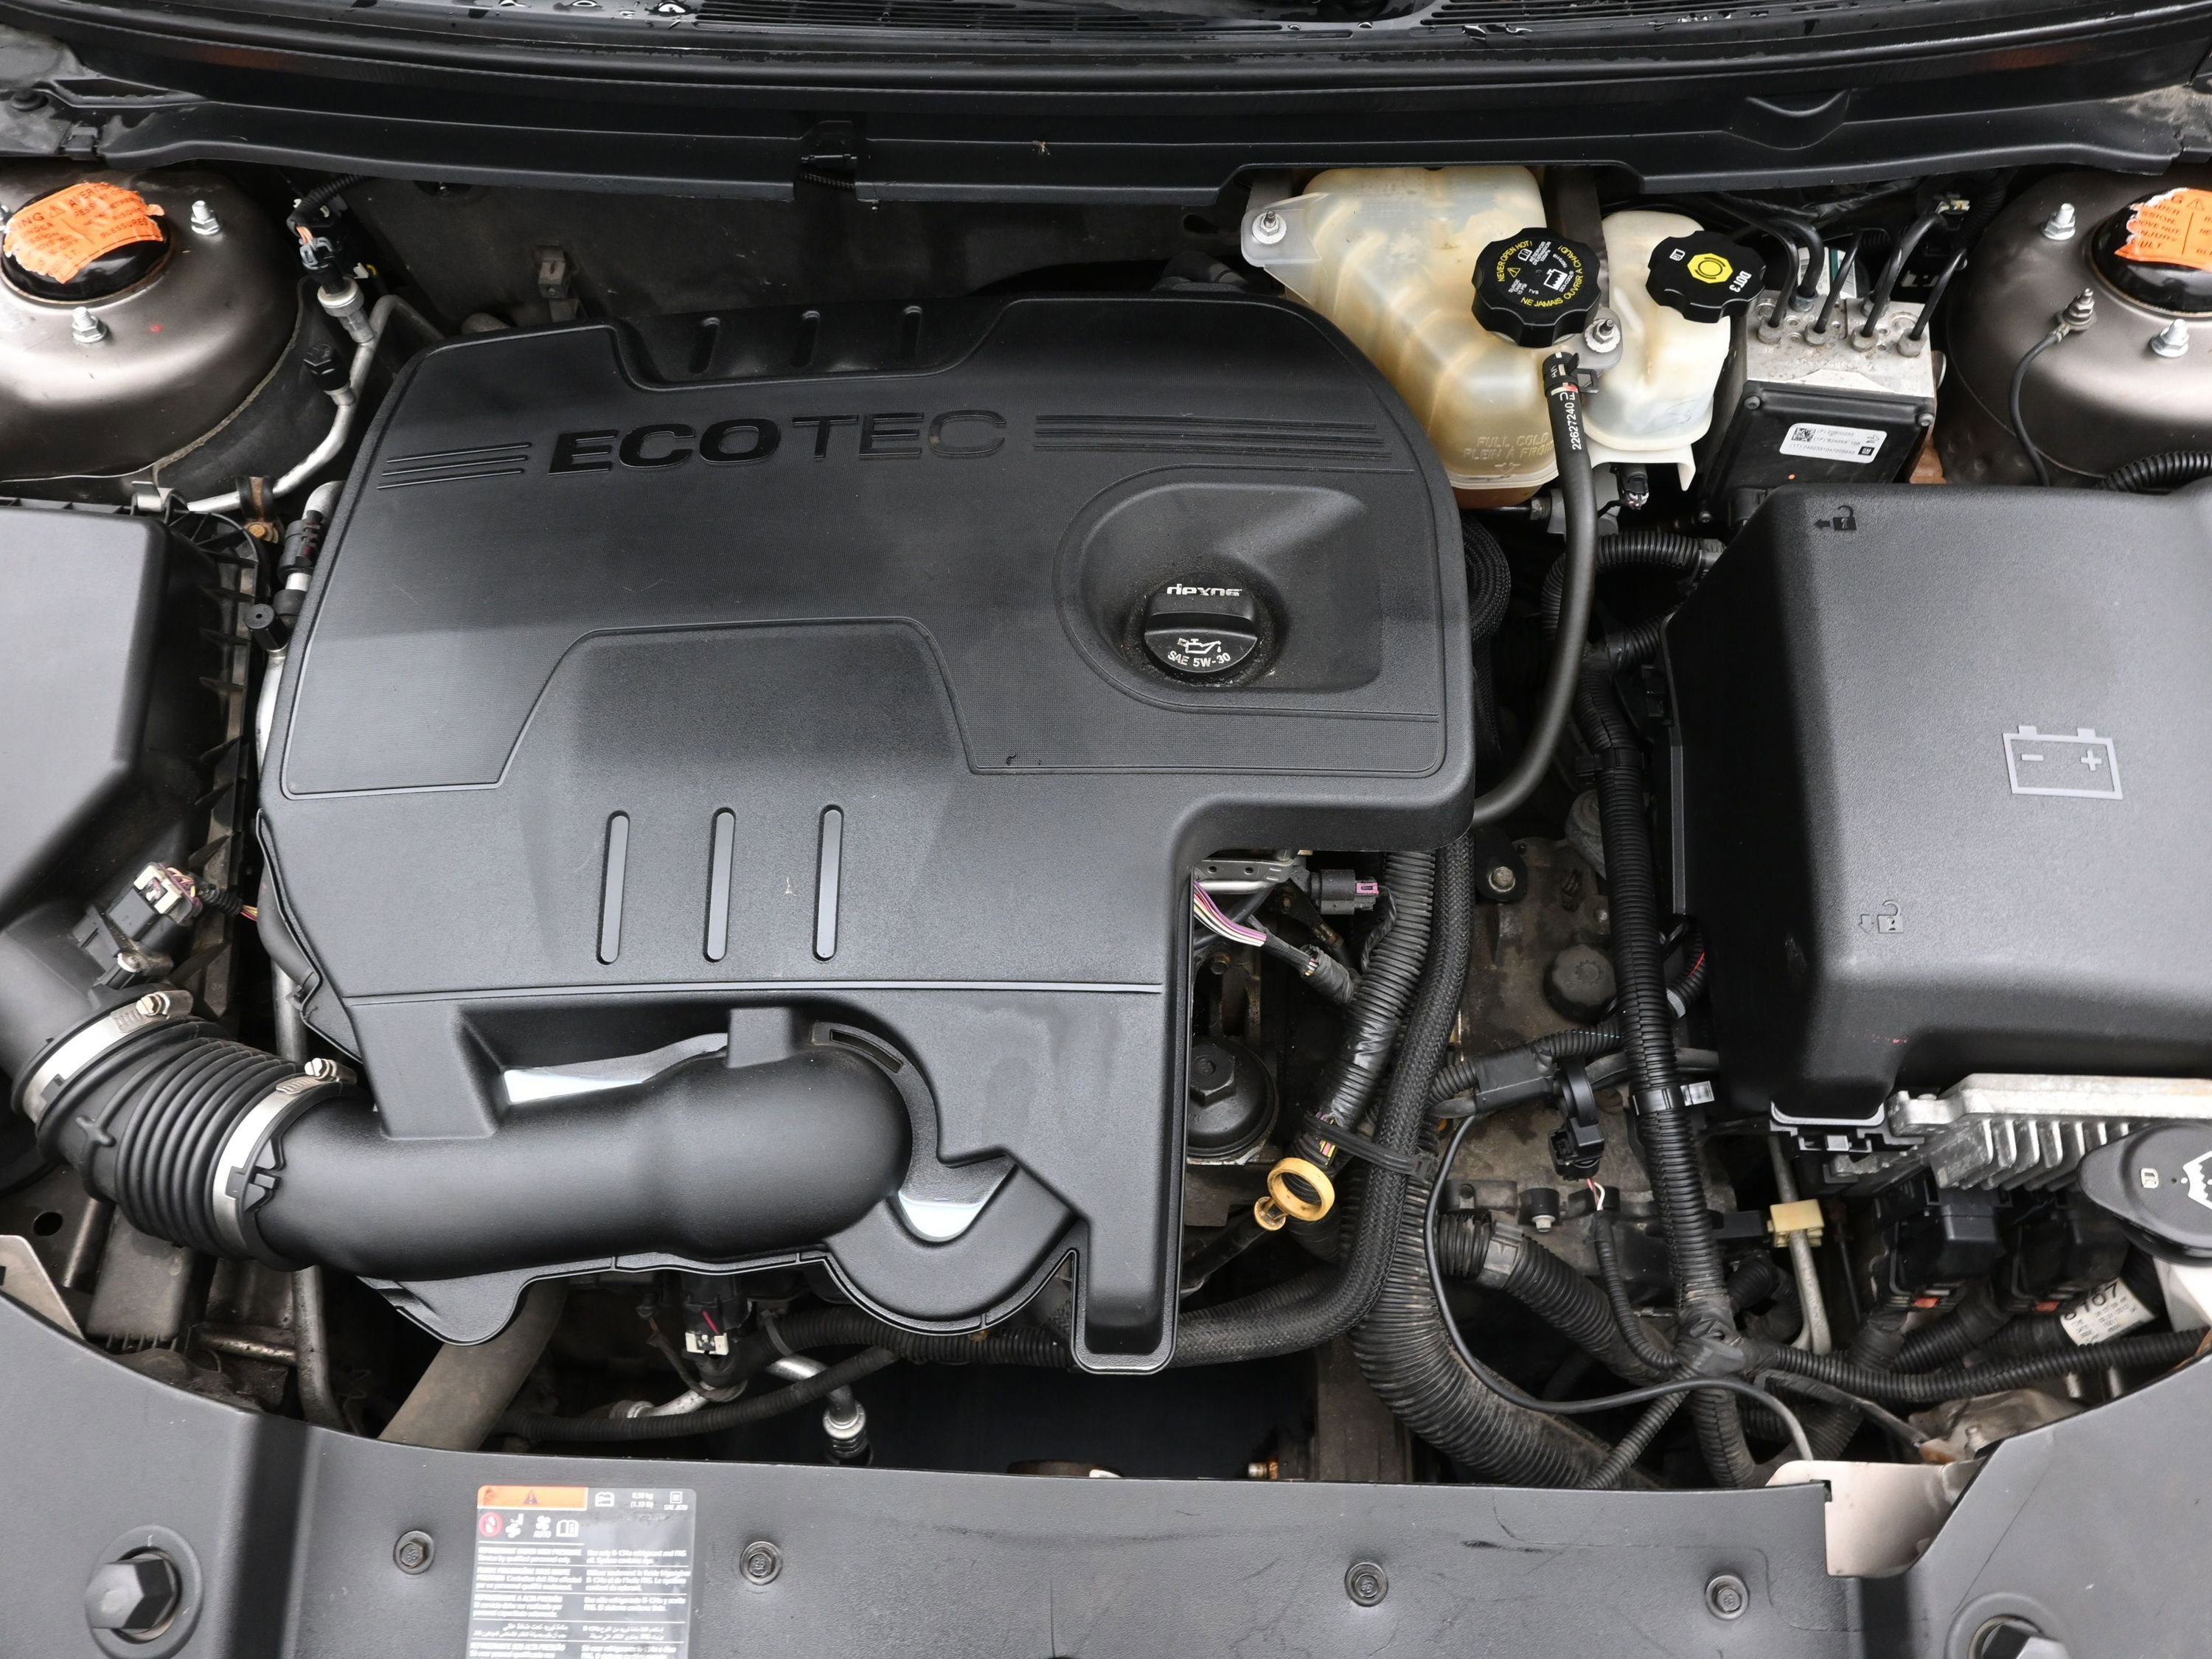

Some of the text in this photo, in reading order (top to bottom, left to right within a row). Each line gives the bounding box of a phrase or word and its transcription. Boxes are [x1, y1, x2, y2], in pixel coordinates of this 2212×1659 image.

[1500, 246, 1517, 262] OPEN
[1497, 261, 1506, 282] NEVER
[1729, 270, 1752, 293] DOT 3
[1520, 297, 1534, 306] NE
[1534, 297, 1563, 307] JAMAIS
[1563, 275, 1583, 299] OUVRIR
[1564, 402, 1582, 450] 22627240
[548, 409, 1006, 476] ECOTEC
[1476, 432, 1550, 448] FULL COLD
[1463, 448, 1502, 460] PLEIN
[1167, 650, 1231, 667] SAE 5W-30
